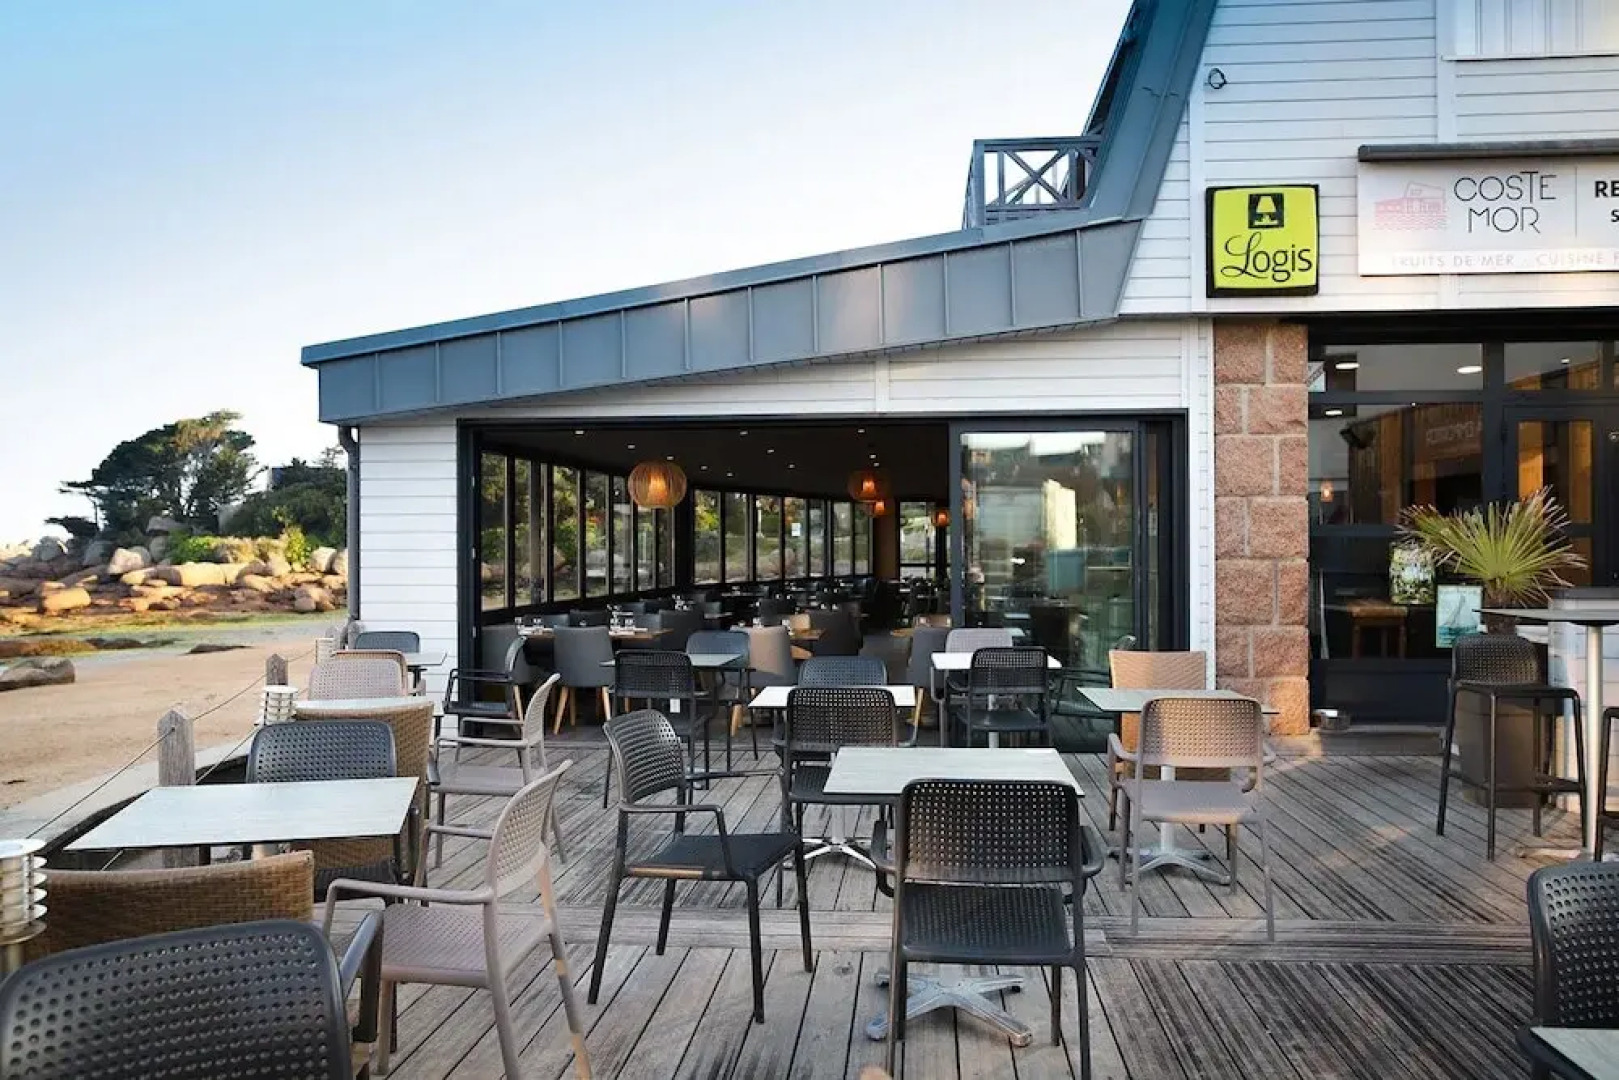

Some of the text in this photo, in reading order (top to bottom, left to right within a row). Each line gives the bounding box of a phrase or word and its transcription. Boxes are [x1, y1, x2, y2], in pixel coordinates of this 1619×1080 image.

[1453, 171, 1557, 204] COSTE
[1595, 180, 1619, 198] RE
[1467, 207, 1541, 234] MOR
[1220, 231, 1313, 282] Logis
